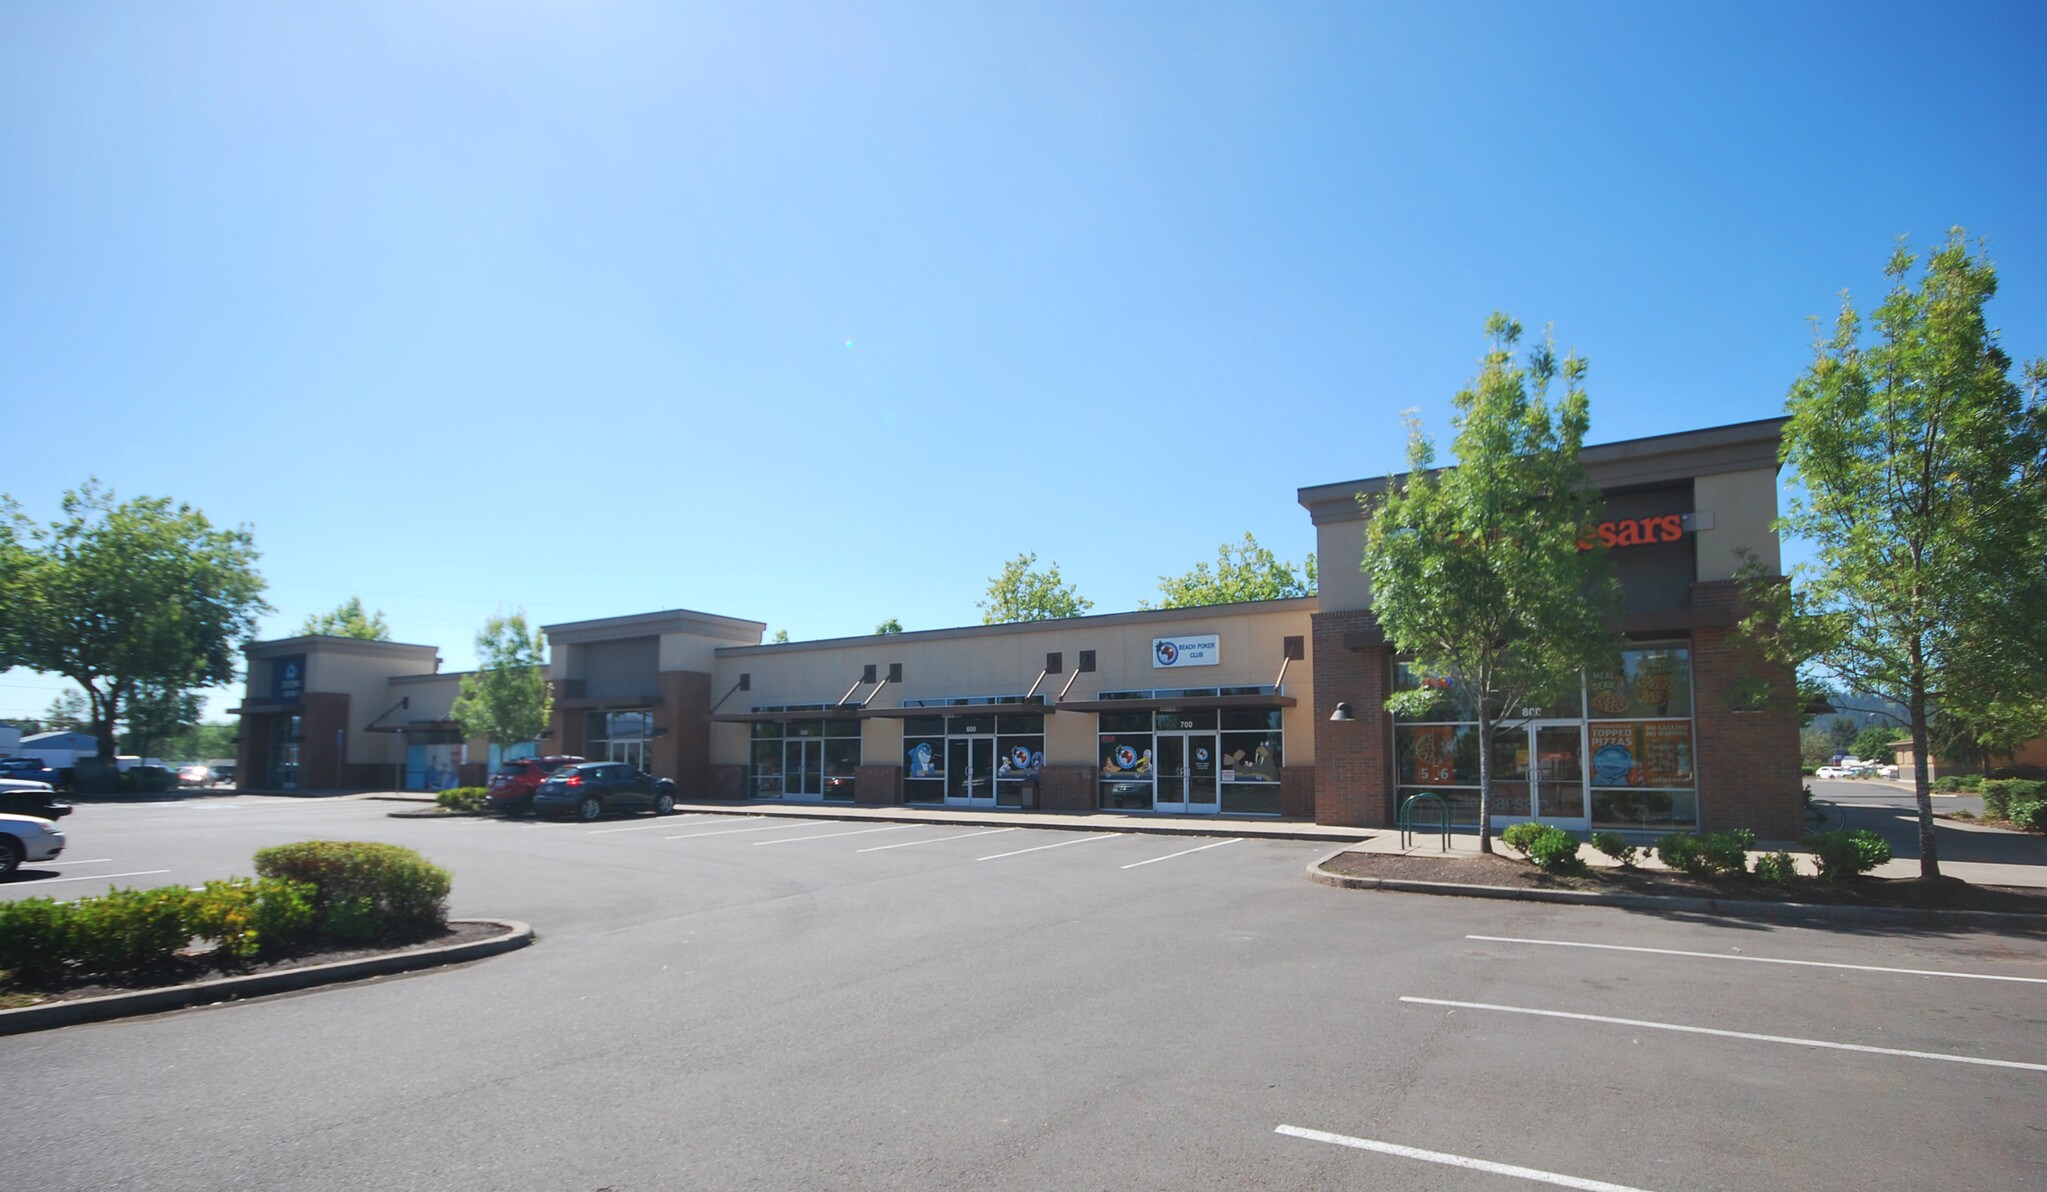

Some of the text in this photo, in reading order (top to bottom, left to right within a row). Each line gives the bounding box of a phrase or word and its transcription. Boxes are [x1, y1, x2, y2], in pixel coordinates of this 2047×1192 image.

[1178, 642, 1215, 651] BEACH POKER
[1592, 728, 1632, 737] TOPPED
[1591, 737, 1632, 747] PIZZAS
